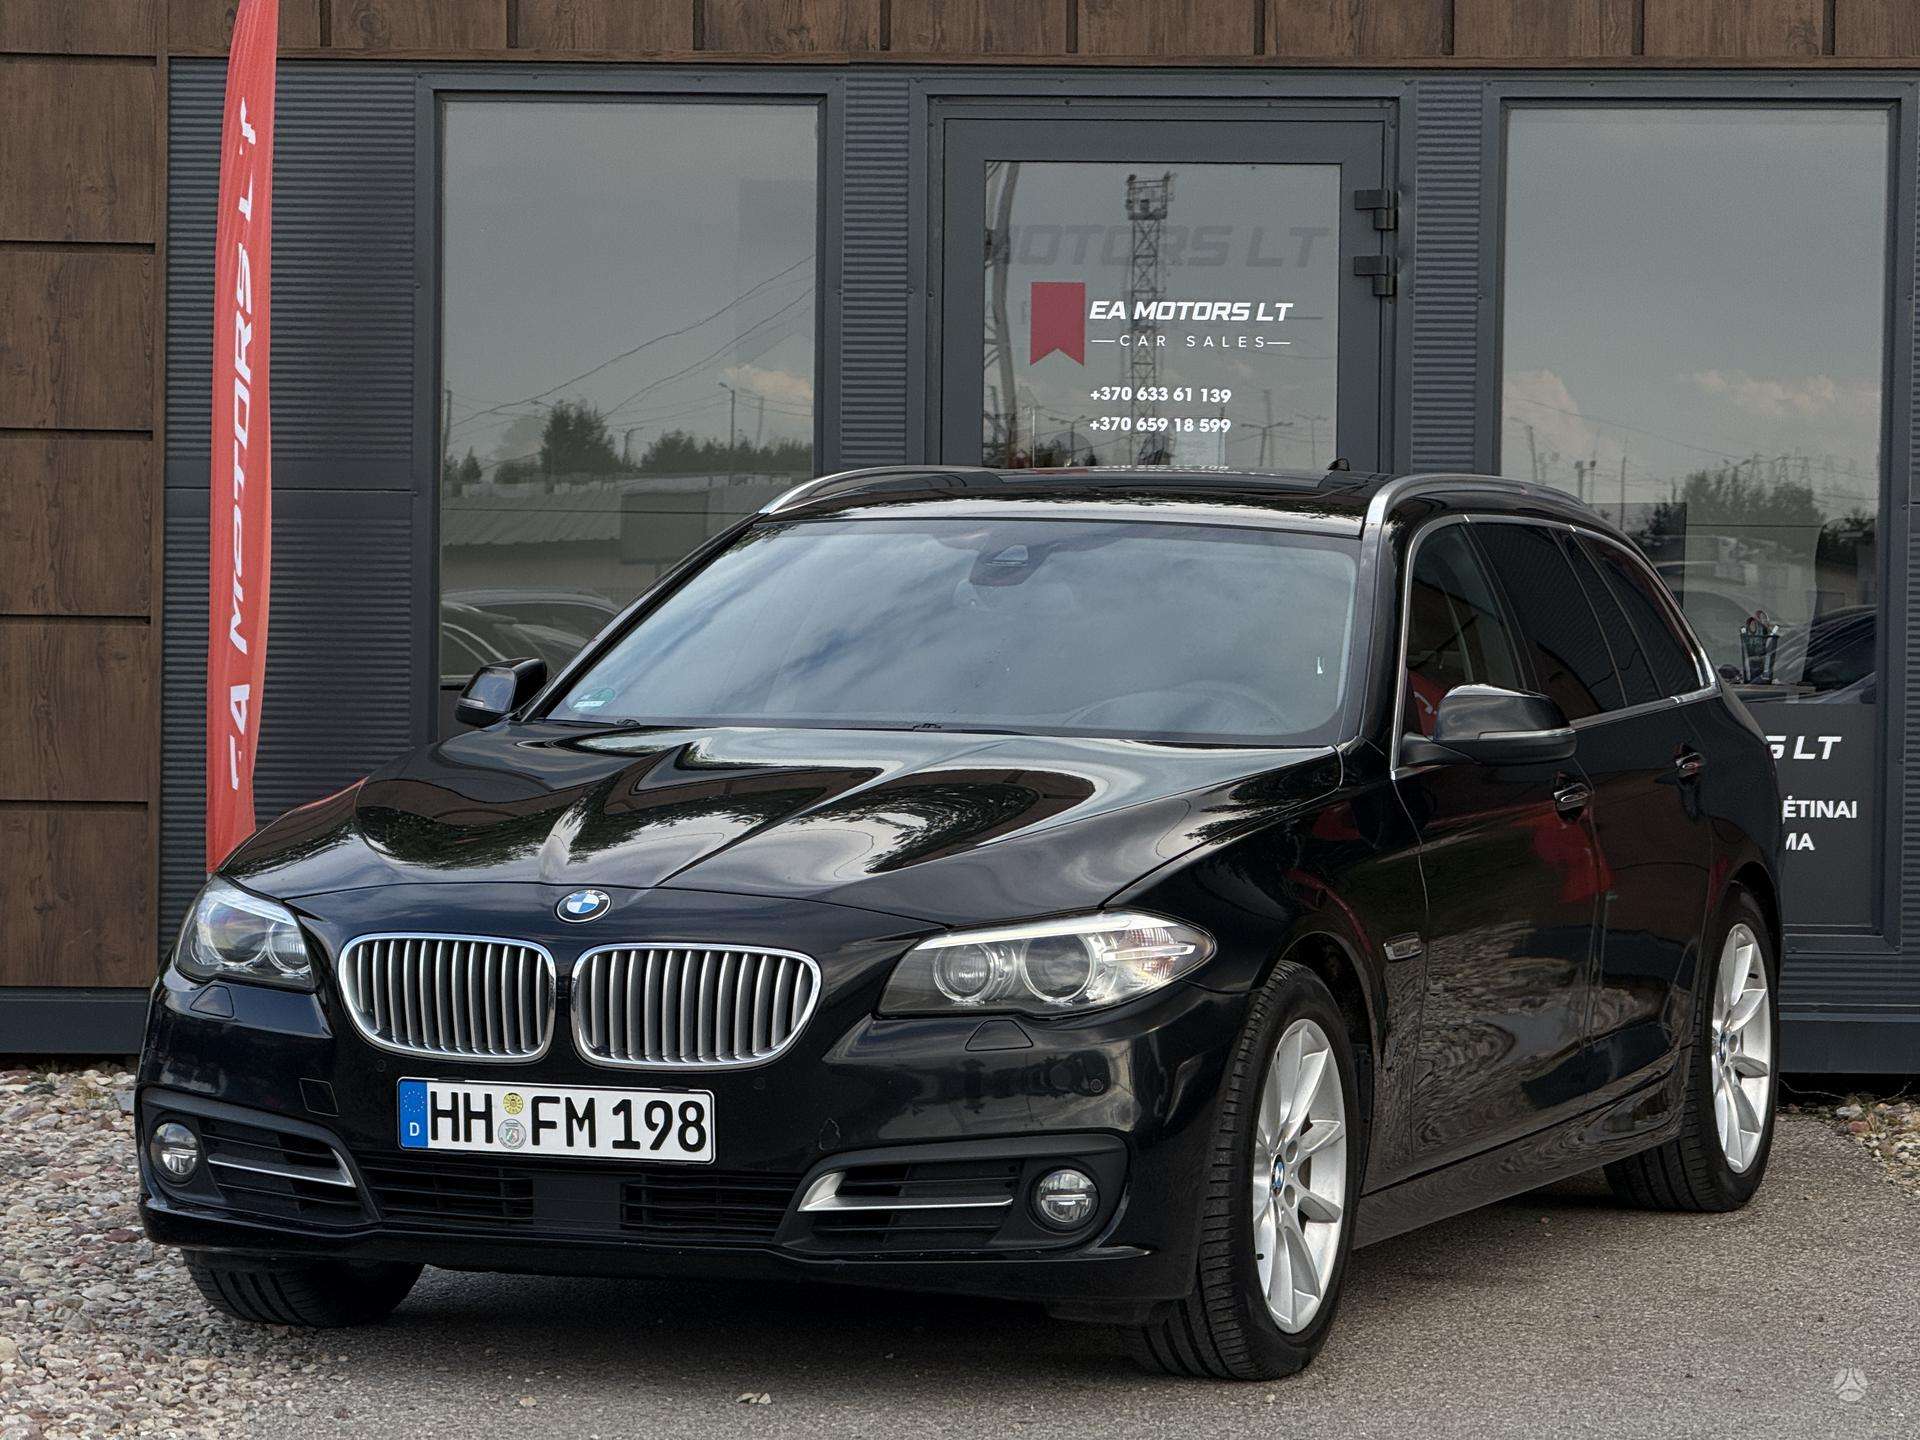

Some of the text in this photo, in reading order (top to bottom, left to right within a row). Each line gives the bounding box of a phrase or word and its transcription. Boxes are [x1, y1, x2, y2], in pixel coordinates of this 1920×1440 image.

[1008, 225, 1233, 267] OTORS
[1089, 301, 1294, 321] EA MOTORS LT
[1119, 334, 1264, 348] CAR SALES
[1090, 386, 1232, 403] +370 633 61 139
[1089, 416, 1232, 433] +370 659 18 599
[229, 242, 252, 654] MOTORS
[1793, 735, 1842, 760] LT
[409, 1122, 420, 1137] D
[430, 1090, 494, 1144] HH
[531, 1095, 597, 1148] FM
[611, 1099, 707, 1152] 198
